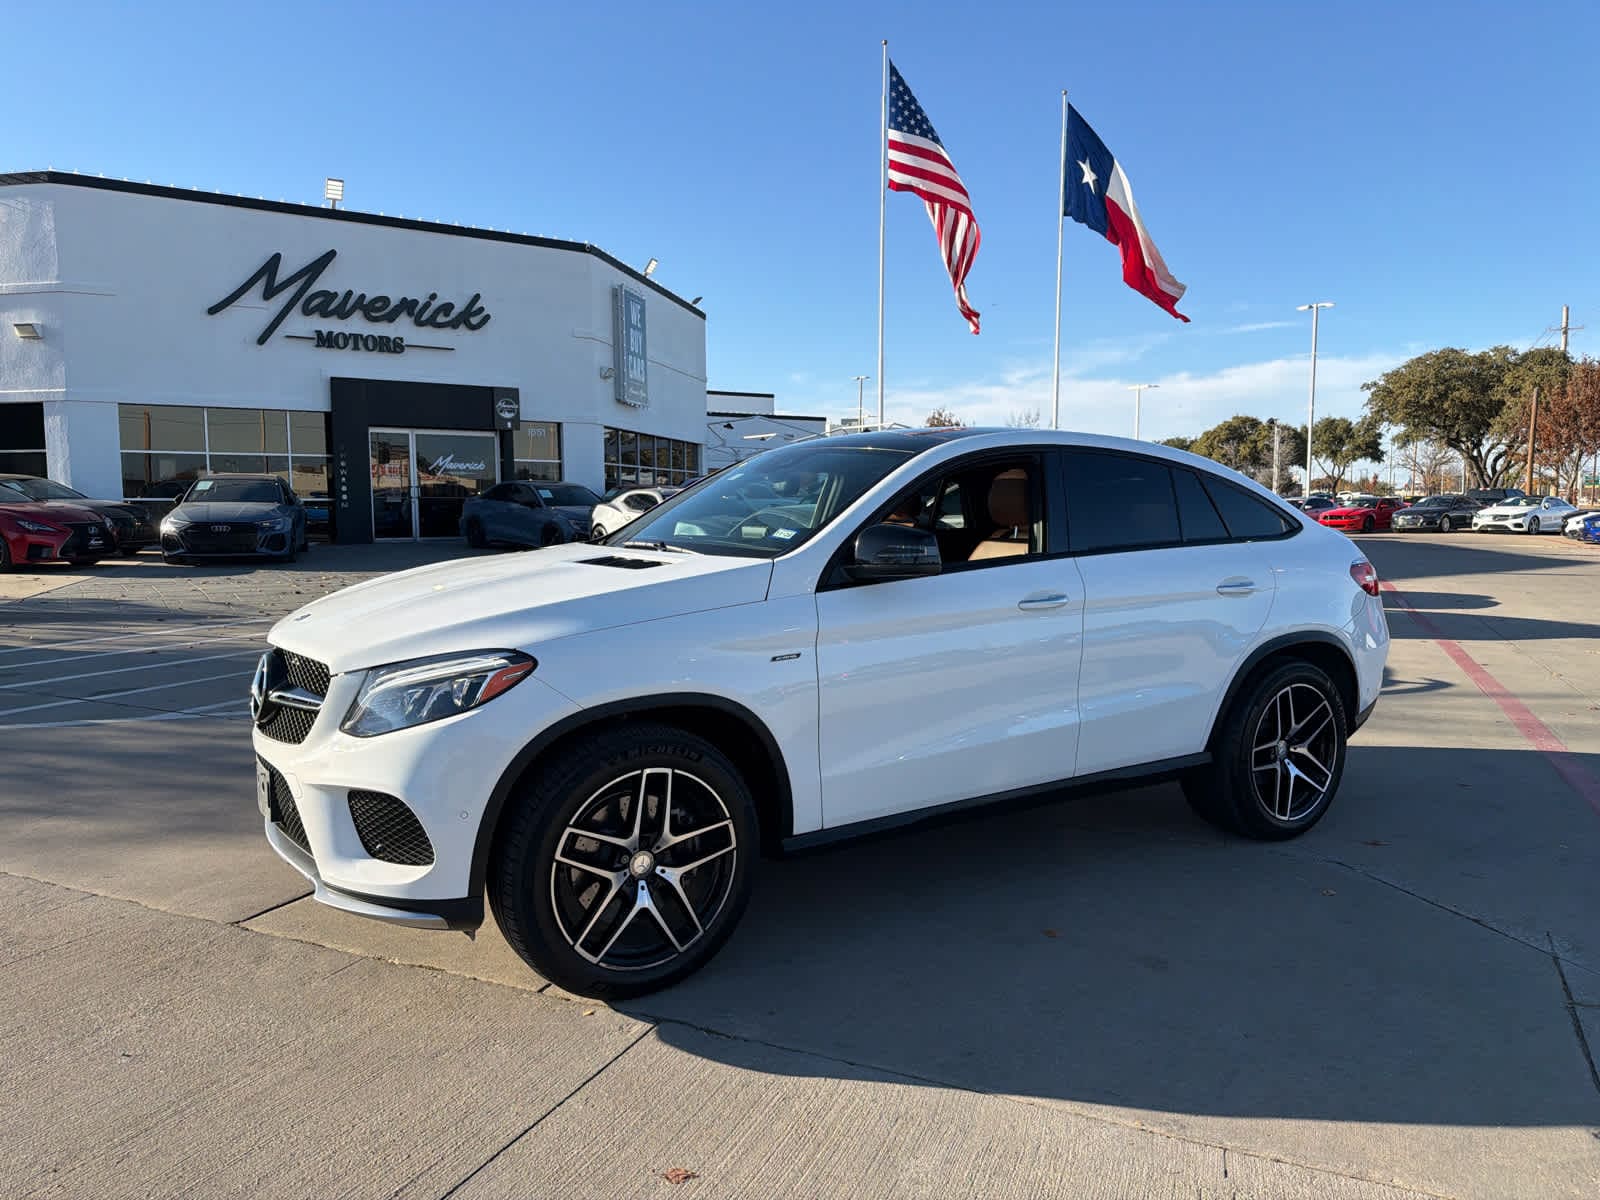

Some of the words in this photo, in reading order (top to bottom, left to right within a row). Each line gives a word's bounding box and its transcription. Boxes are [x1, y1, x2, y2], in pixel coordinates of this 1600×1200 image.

[208, 249, 491, 345] Maverick
[314, 330, 405, 353] MOTORS
[429, 454, 486, 476] Maverick
